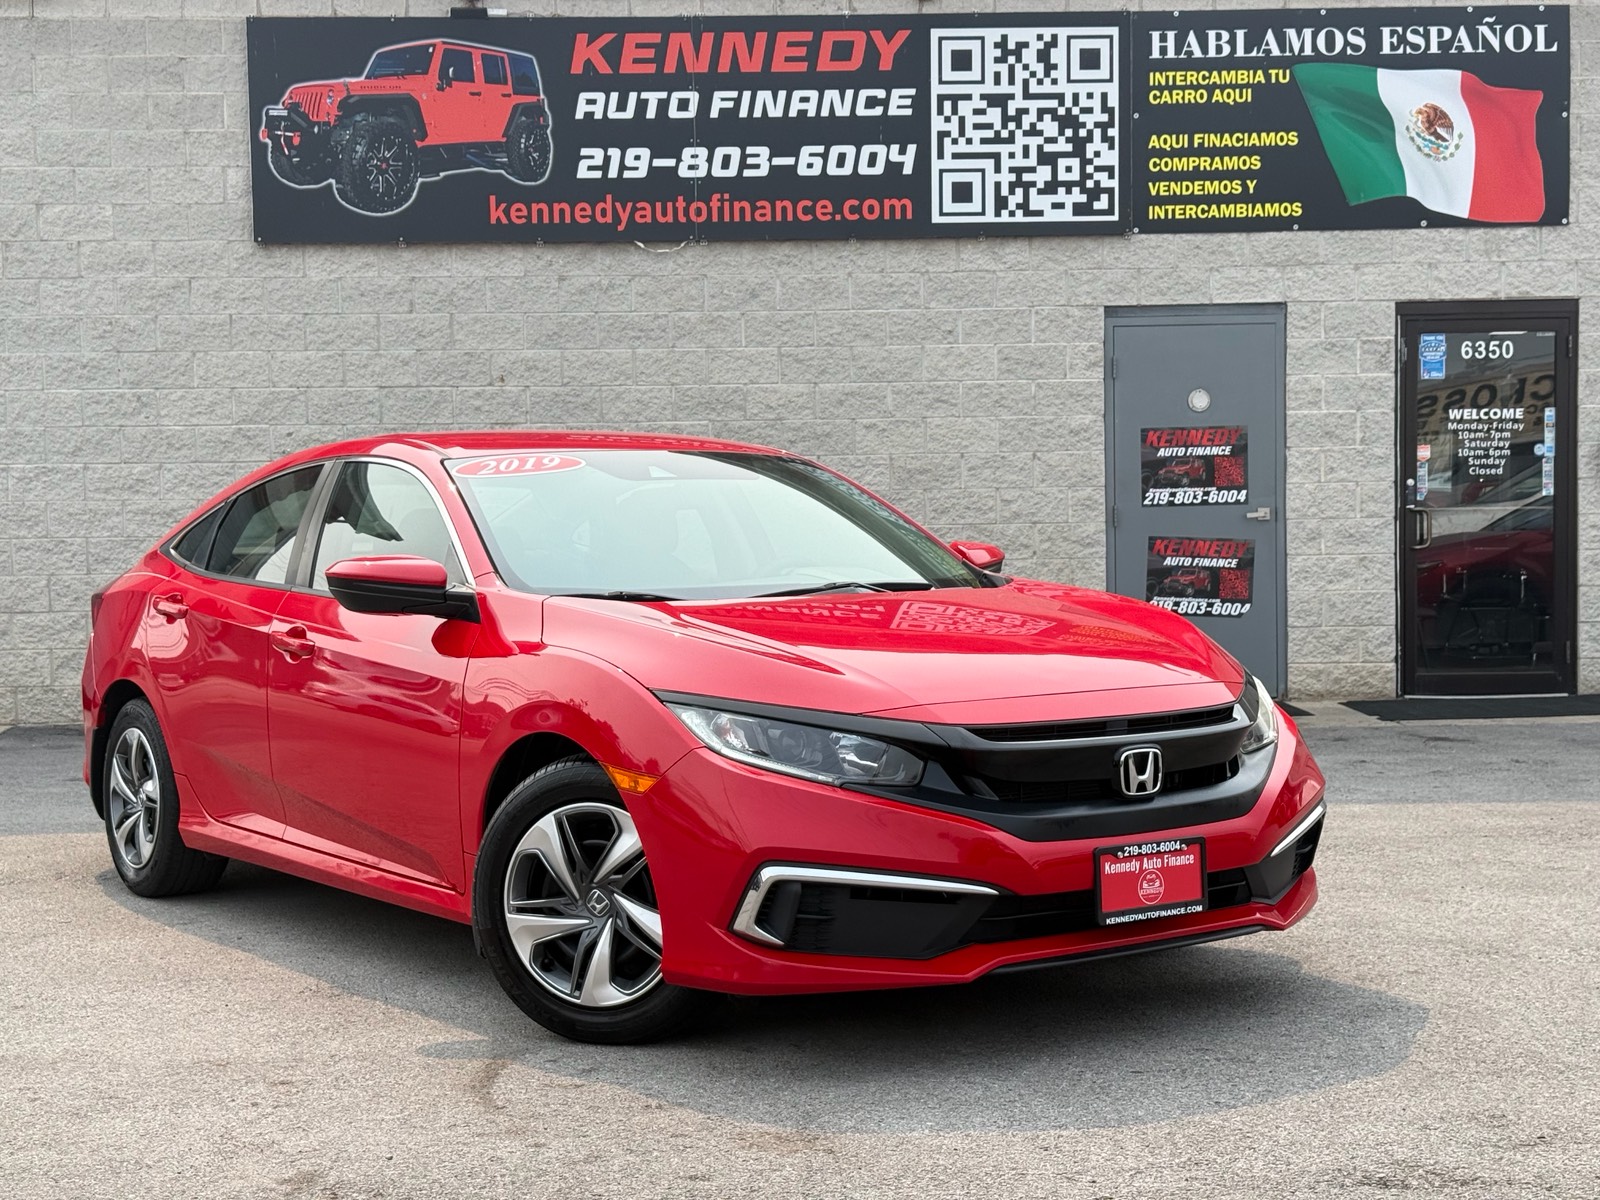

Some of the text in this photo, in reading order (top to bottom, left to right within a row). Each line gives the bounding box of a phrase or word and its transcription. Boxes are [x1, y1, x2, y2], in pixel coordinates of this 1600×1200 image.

[1149, 16, 1558, 59] HABLAMOS ESPAÑOL
[570, 30, 911, 74] KENNEDY
[1149, 69, 1290, 86] INTERCAMBIA TU
[574, 88, 917, 120] AUTO FINANCE
[1149, 88, 1252, 105] CARRO AQUI
[1149, 131, 1298, 150] AQUI FINACIAMOS
[577, 144, 917, 180] 219-803-6004
[1149, 156, 1261, 172] COMPRAMOS
[1149, 179, 1258, 196] VENDEMOS Y
[488, 195, 912, 231] kennedyautofinance.com
[1149, 203, 1303, 220] INTERCAMBIAMOS
[1461, 340, 1514, 359] 6350
[1448, 408, 1525, 420] WELCOME
[1448, 422, 1525, 432] Monday-Friday
[1145, 428, 1242, 447] KENNEDY
[1464, 440, 1510, 449] Saturday
[1157, 446, 1232, 457] AUTO FINANCE
[1458, 449, 1511, 458] 10am-6pm
[477, 456, 561, 475] 2019
[1468, 457, 1506, 466] Sunday
[1469, 466, 1503, 475] Closed
[1143, 490, 1247, 505] 219-803-6004
[1152, 538, 1249, 557] KENNEDY
[1163, 556, 1239, 568] AUTO FINANCE
[1124, 841, 1180, 856] 219-803-6004
[1105, 854, 1194, 874] Kennedy Auto Finance
[1106, 905, 1202, 925] KENNEDYAUTOFINANCE.COM
